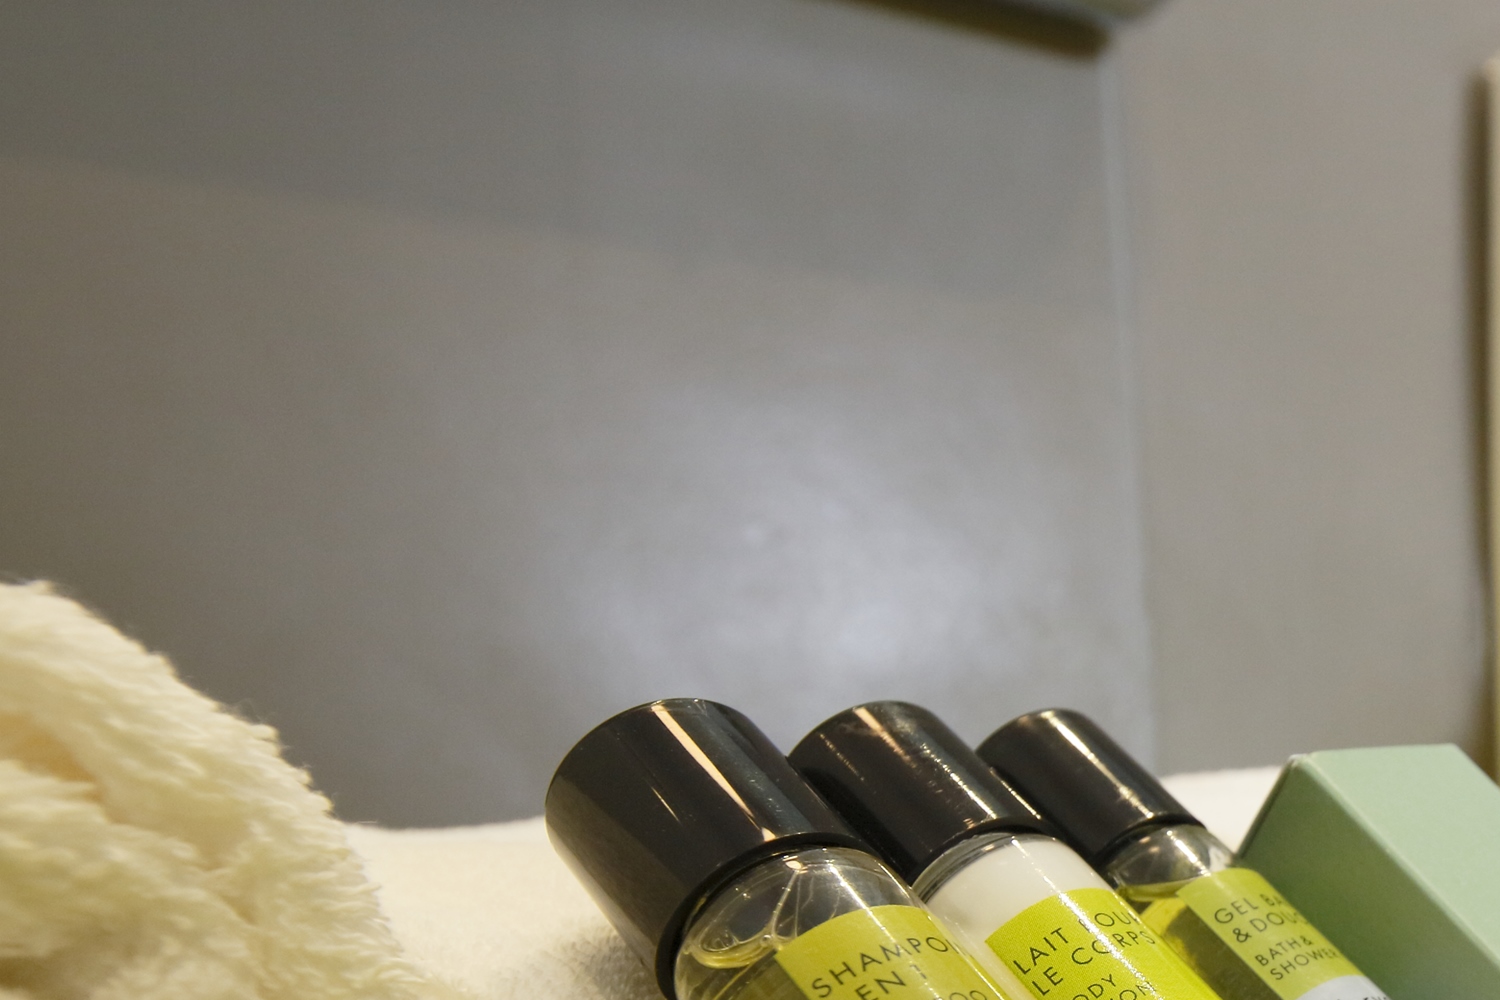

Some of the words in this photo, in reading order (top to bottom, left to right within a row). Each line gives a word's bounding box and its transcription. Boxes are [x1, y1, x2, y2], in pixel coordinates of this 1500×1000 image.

[1214, 897, 1259, 924] GEL
[1232, 927, 1252, 943] &
[1013, 927, 1070, 975] LAIT
[1031, 966, 1064, 997] LE
